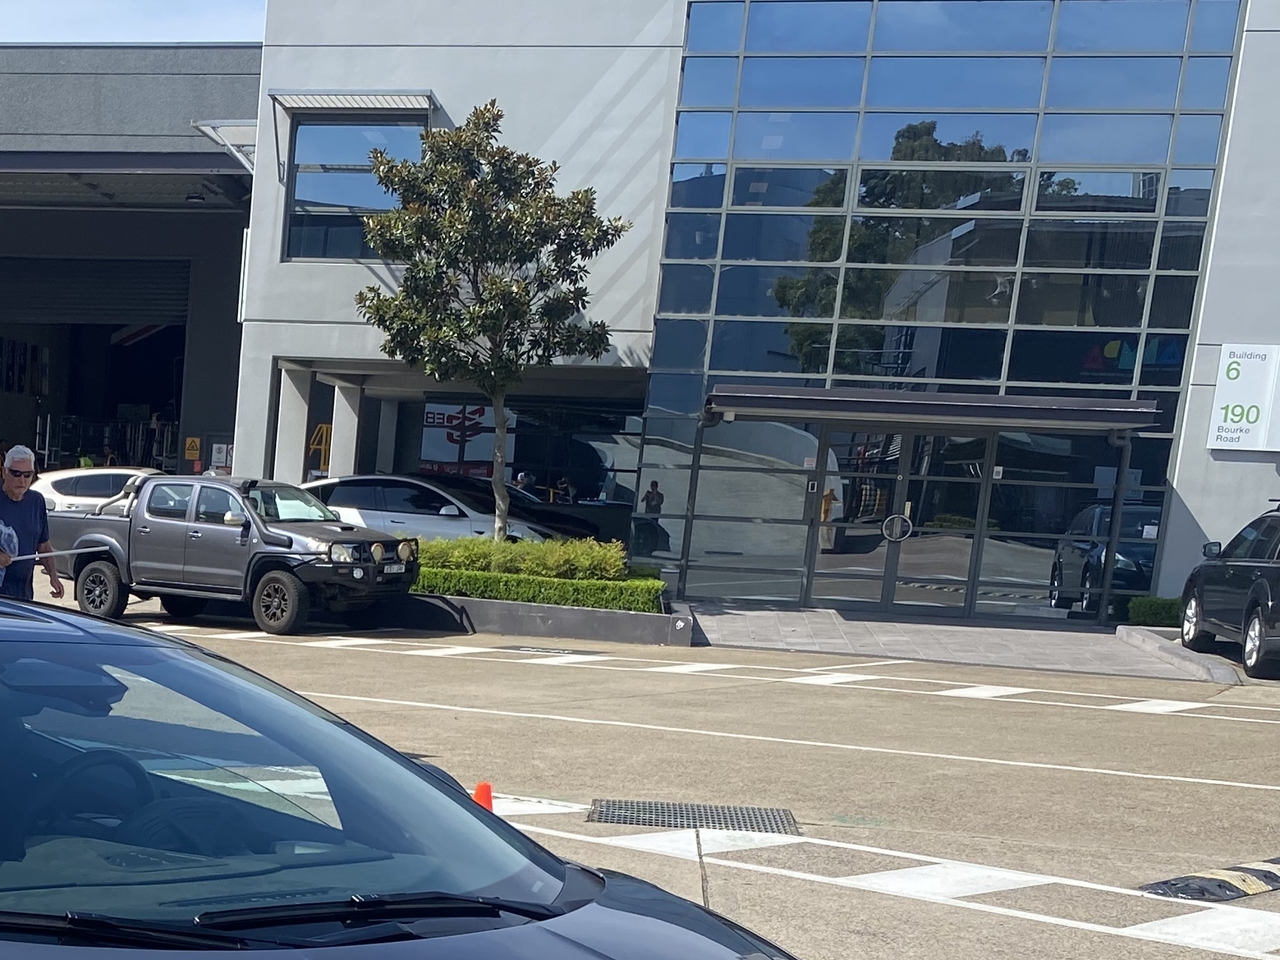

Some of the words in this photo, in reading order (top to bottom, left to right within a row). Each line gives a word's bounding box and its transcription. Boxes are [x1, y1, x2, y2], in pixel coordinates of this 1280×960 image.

[1229, 351, 1267, 361] Building
[1226, 361, 1241, 381] 6
[1220, 404, 1261, 424] 190
[1217, 426, 1250, 435] Bourke
[1216, 435, 1240, 443] Road
